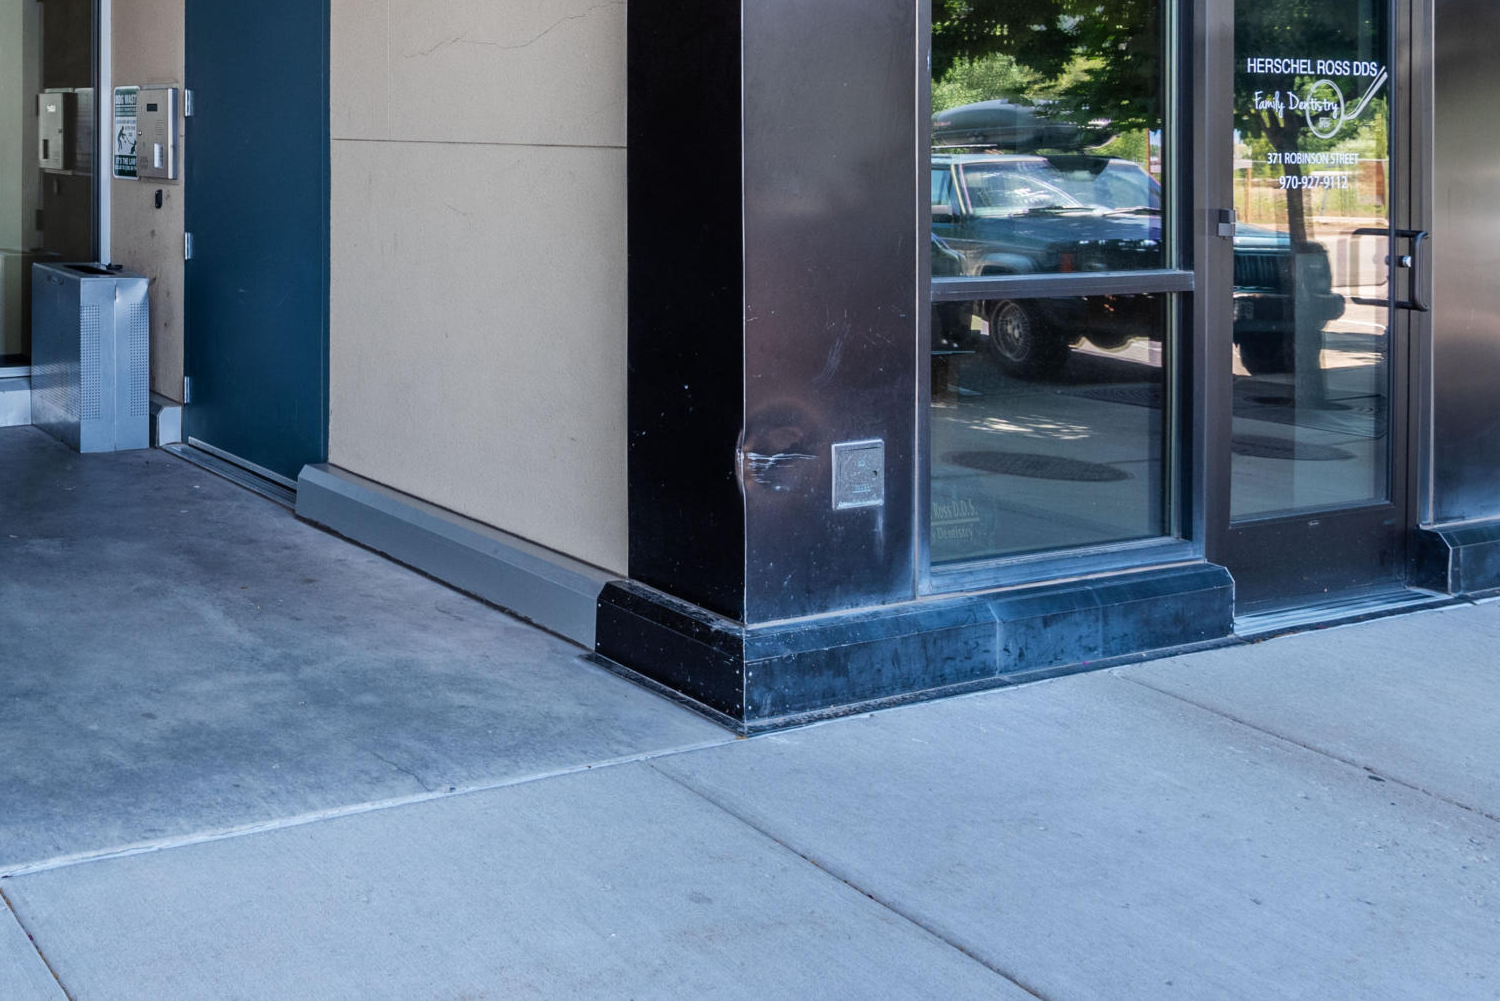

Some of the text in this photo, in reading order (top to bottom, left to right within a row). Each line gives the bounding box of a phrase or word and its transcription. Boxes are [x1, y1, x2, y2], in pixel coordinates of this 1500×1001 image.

[1247, 58, 1378, 76] HERSCHEL ROSS DDS
[1254, 90, 1339, 119] Family Dentistry
[1267, 153, 1359, 164] 371 ROBINSON STREET
[1278, 175, 1348, 190] 970-927-9112
